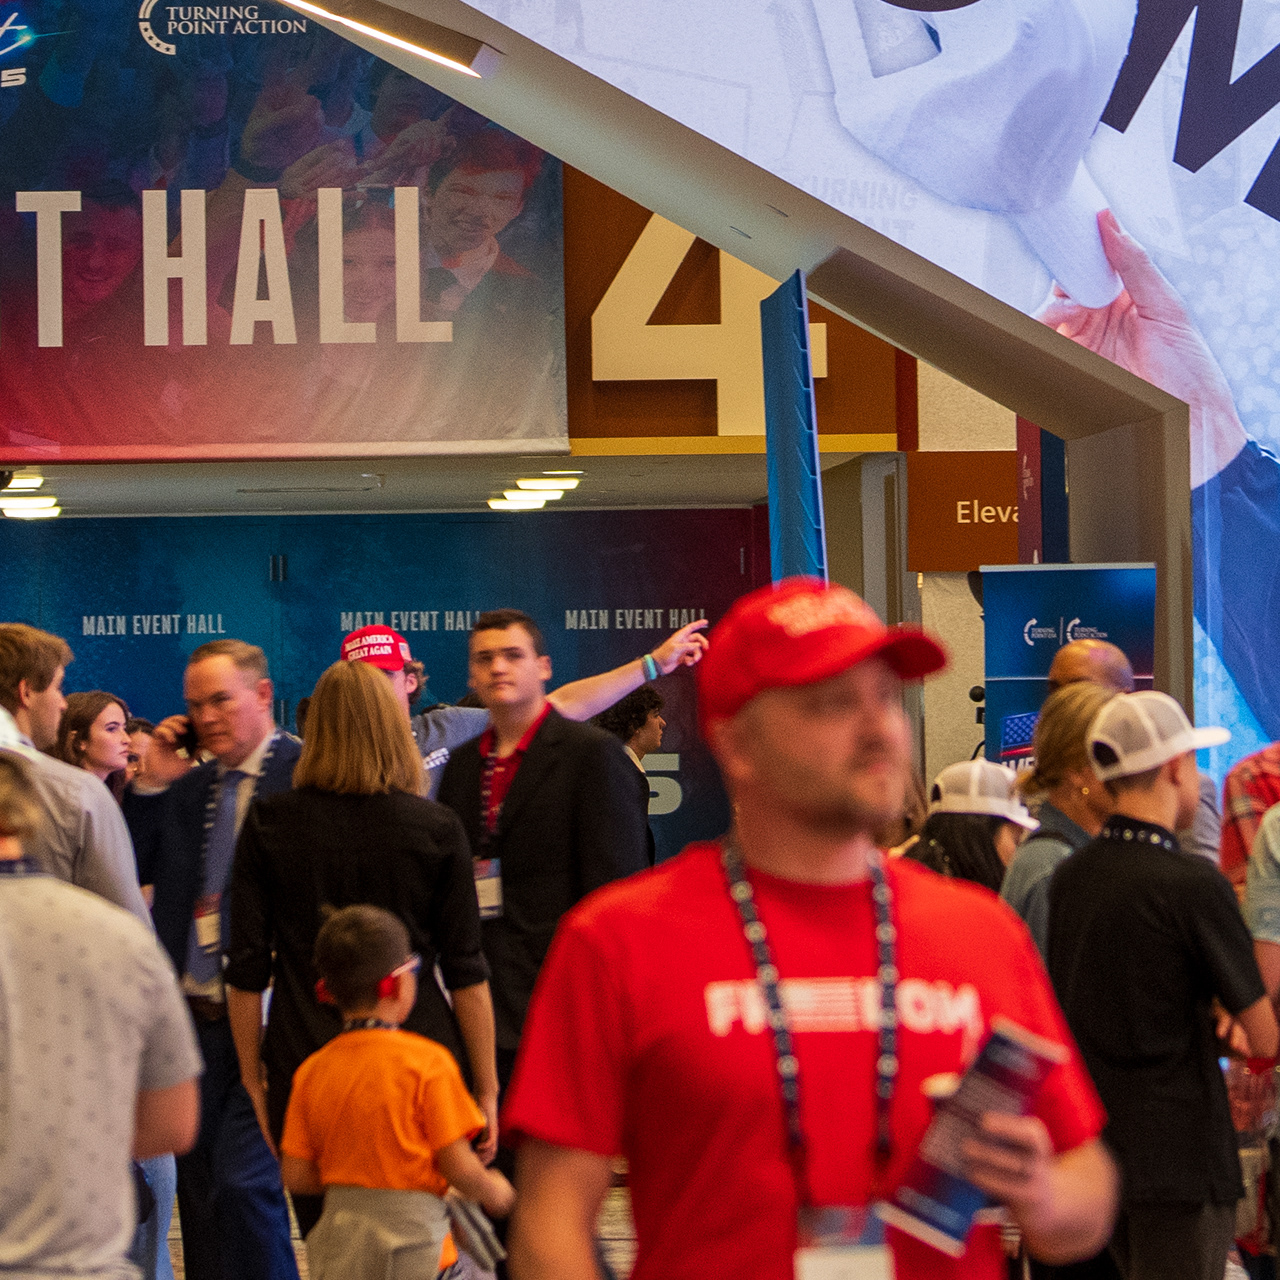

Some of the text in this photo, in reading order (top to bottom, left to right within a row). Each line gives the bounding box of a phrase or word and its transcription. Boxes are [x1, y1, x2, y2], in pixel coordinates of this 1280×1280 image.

[166, 5, 259, 21] TURNING
[167, 19, 308, 35] POINT ACTION
[142, 186, 453, 347] HALL
[591, 210, 827, 436] 4
[82, 613, 226, 636] MAIN EVENT HALL
[391, 611, 439, 631] EVENT
[565, 609, 609, 630] MAIN
[615, 609, 663, 629] EVENT
